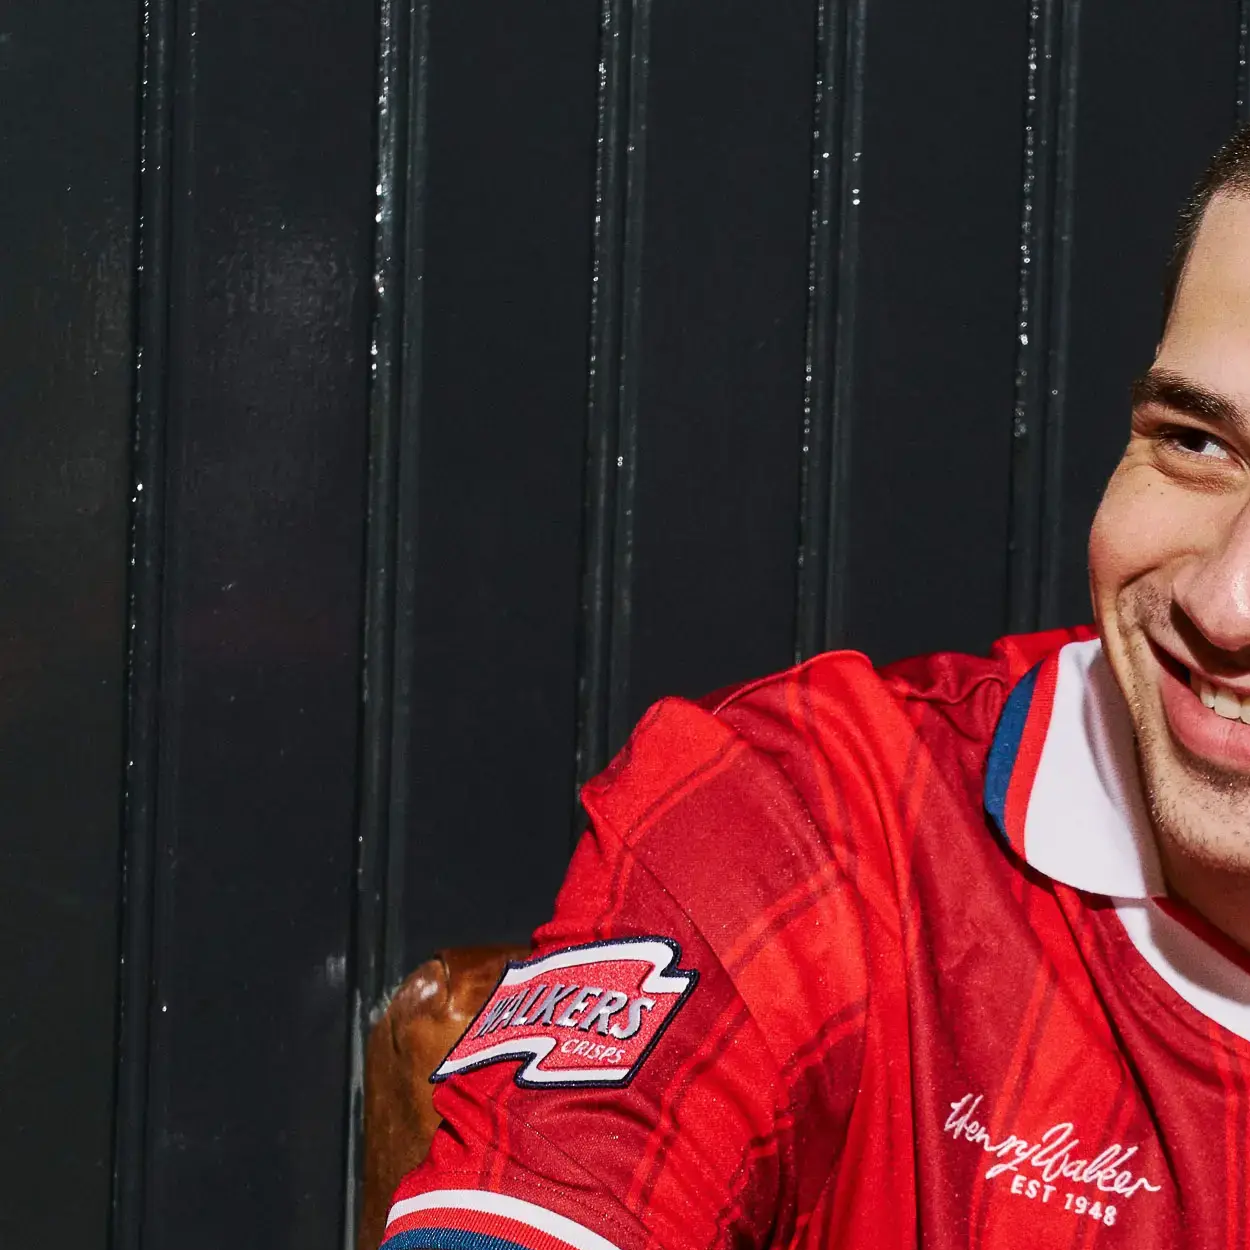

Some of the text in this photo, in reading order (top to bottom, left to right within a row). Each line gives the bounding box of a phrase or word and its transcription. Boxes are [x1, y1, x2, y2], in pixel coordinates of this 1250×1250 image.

[471, 983, 656, 1041] WALKERS
[560, 1037, 626, 1064] CRISPS
[1010, 1174, 1118, 1227] EST 1948
